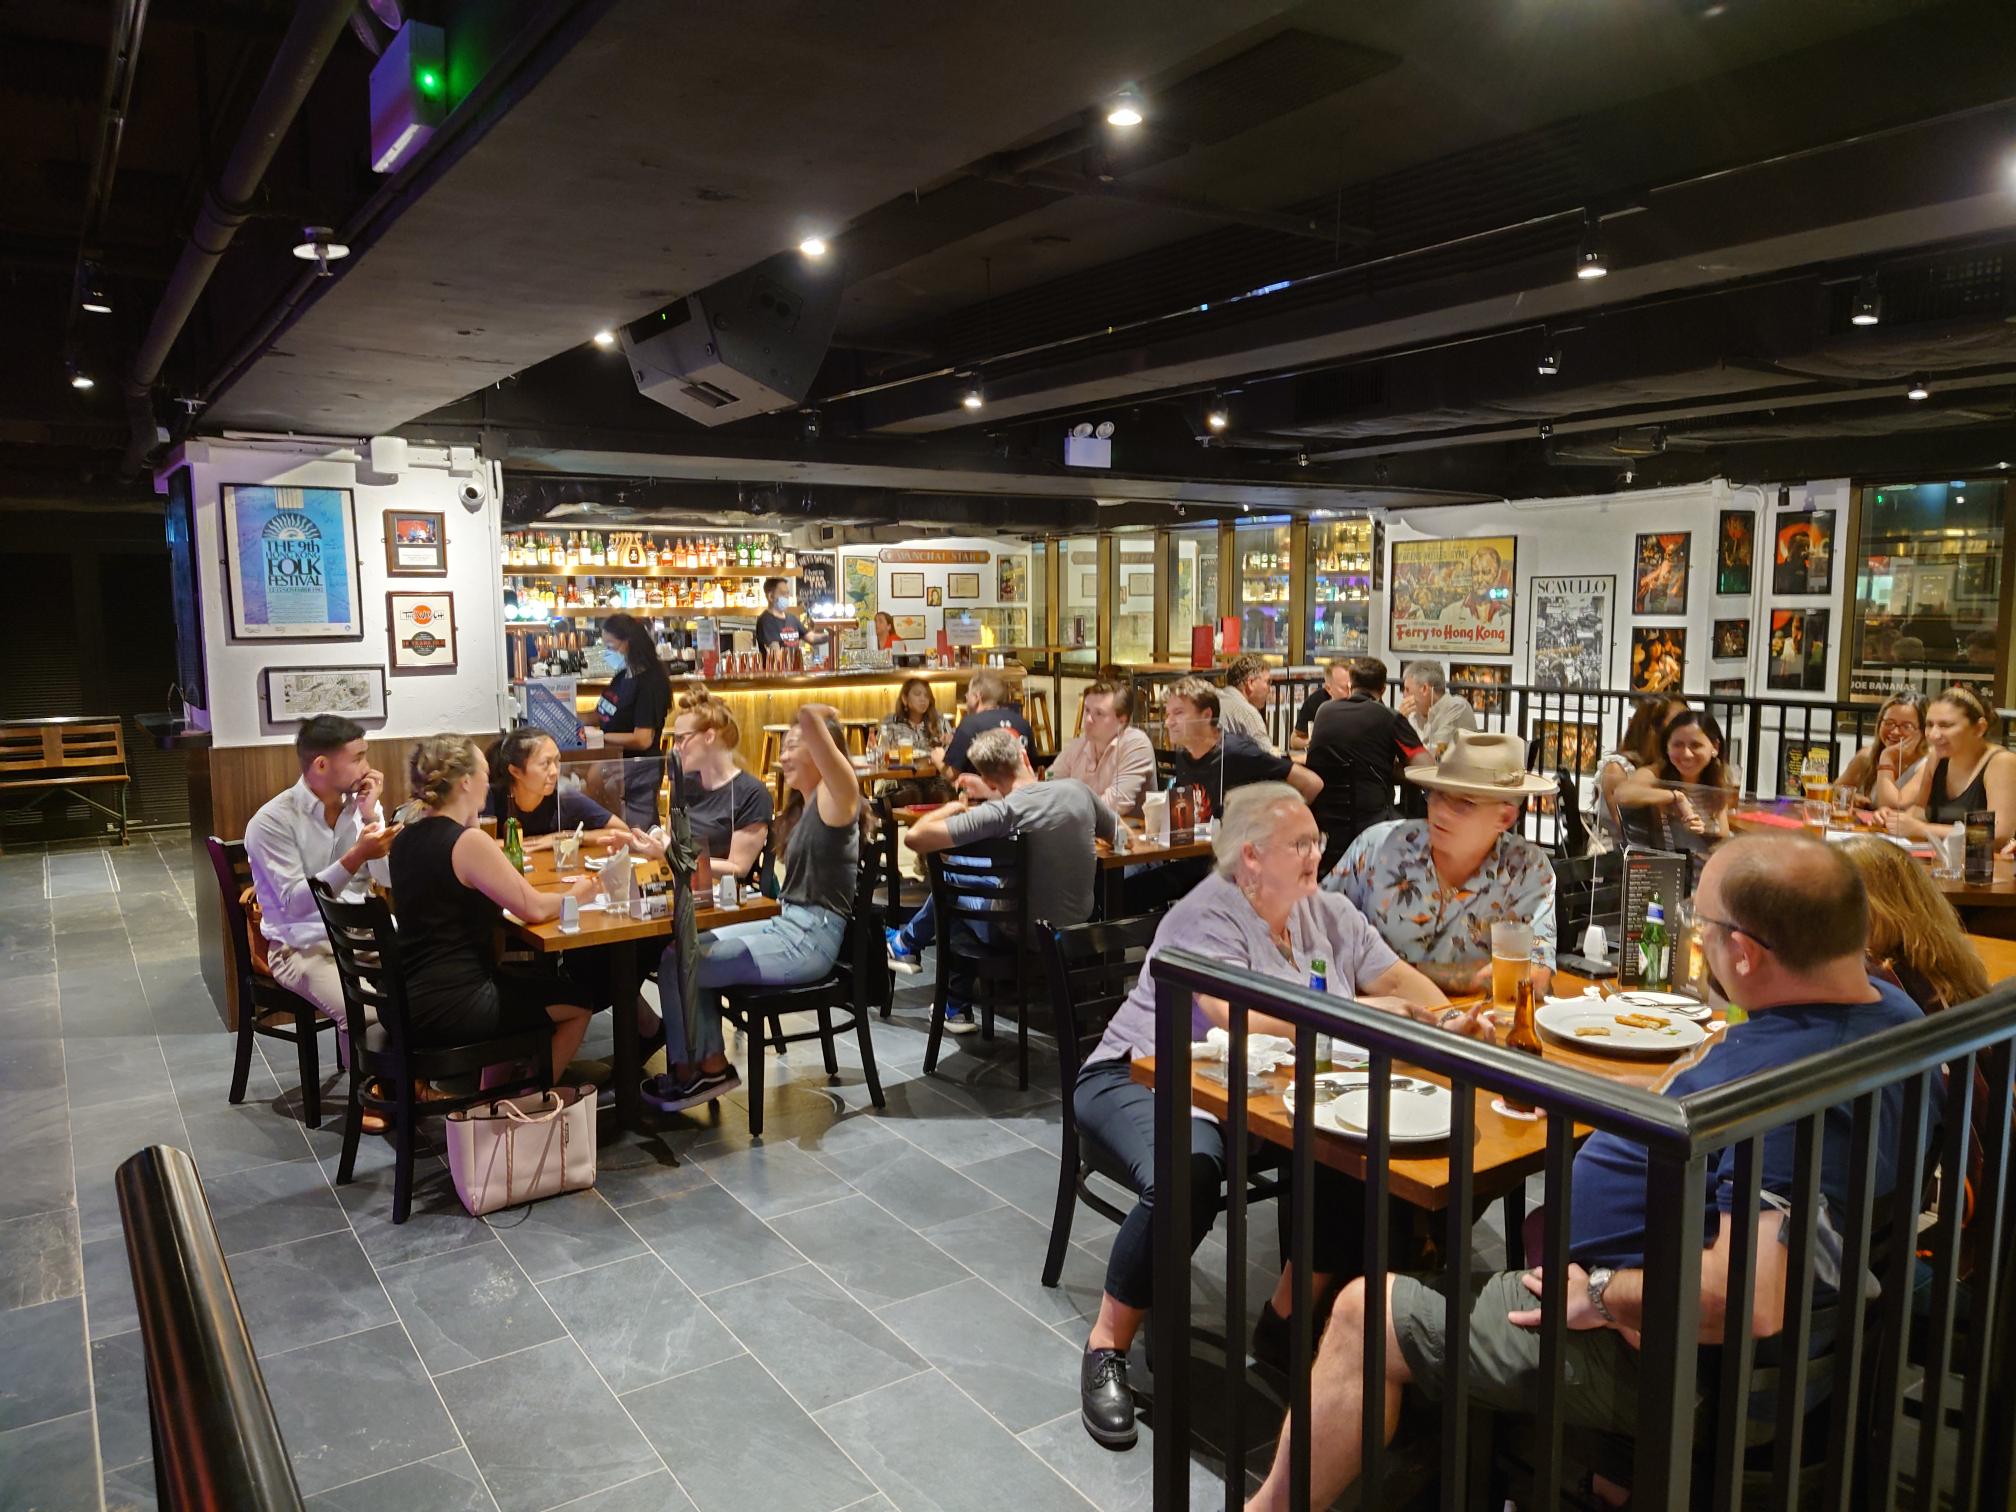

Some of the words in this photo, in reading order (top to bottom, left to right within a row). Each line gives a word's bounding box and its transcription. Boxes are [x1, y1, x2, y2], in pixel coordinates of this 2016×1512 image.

[266, 540, 294, 552] THE
[297, 539, 320, 552] 9th
[267, 558, 322, 577] FOLK
[268, 575, 323, 586] FESTIVAL
[1537, 580, 1606, 594] SCAVULLO
[1396, 624, 1429, 641] Ferry
[1431, 627, 1442, 638] to
[1444, 624, 1474, 641] Hong
[1475, 624, 1505, 642] Kong
[1850, 681, 1867, 690] JOE
[1868, 681, 1916, 691] BANANAS
